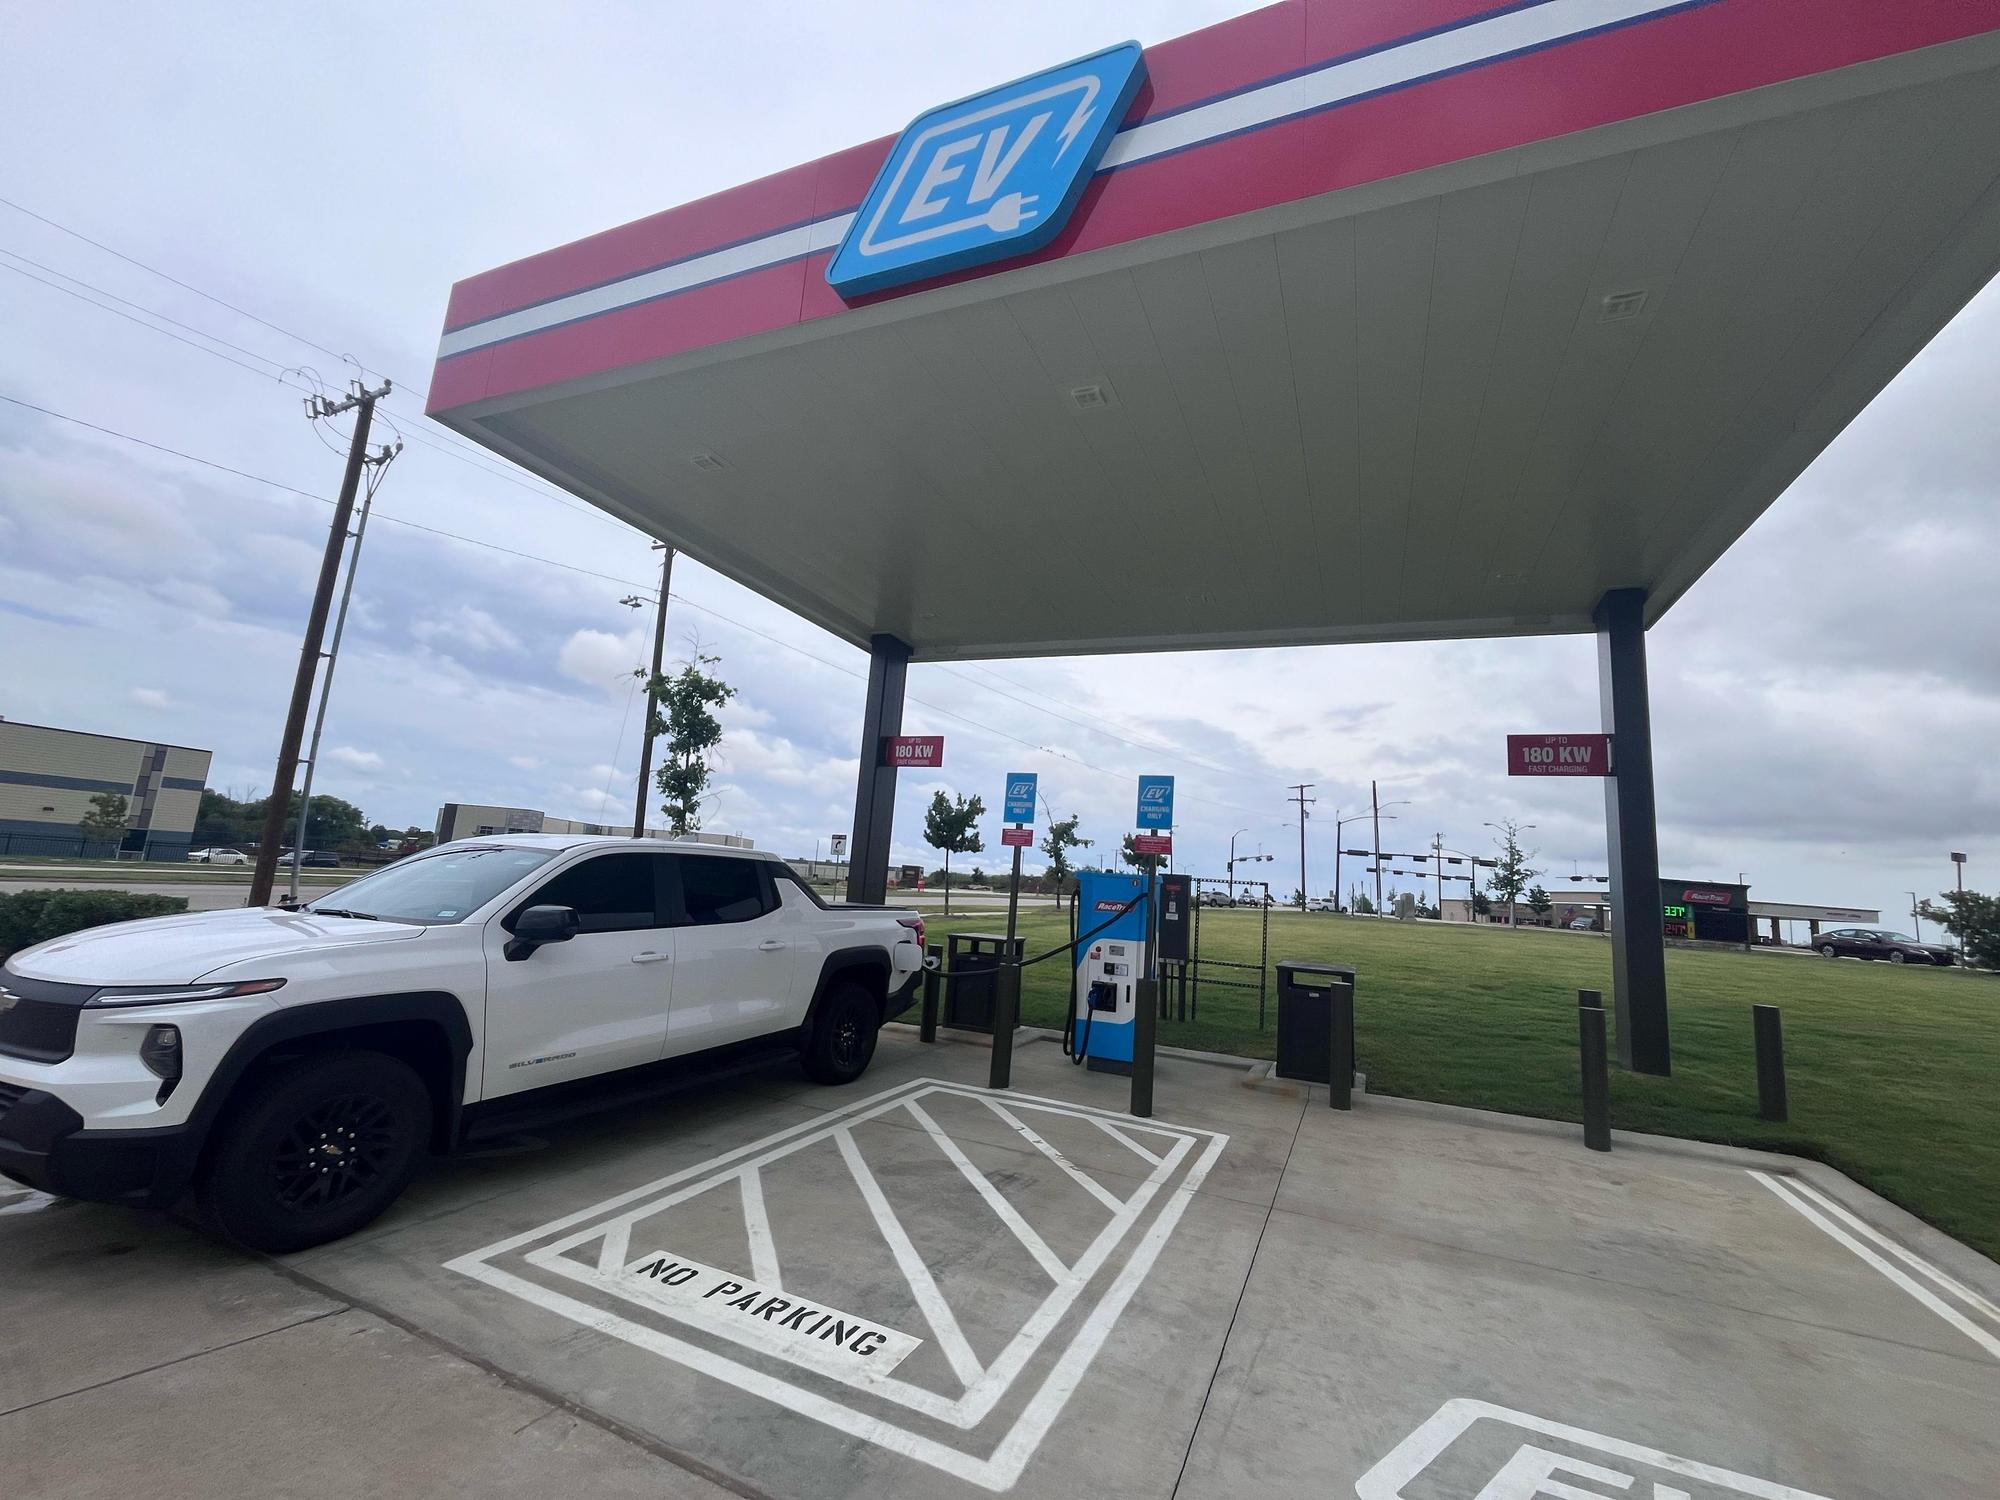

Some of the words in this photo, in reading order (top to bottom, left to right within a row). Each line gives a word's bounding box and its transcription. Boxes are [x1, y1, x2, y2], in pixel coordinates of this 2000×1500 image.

[898, 111, 1053, 225] EV
[1545, 736, 1556, 744] UP
[1558, 736, 1568, 744] TO
[896, 745, 912, 757] 180
[915, 745, 933, 757] KW
[1522, 747, 1554, 763] 180
[1559, 746, 1592, 763] KW
[1528, 765, 1547, 773] FAST
[1548, 765, 1588, 773] CHARGING
[1013, 784, 1029, 795] EV
[1146, 788, 1166, 799] EV
[636, 1258, 699, 1286] NO
[702, 1281, 887, 1356] PARKING
